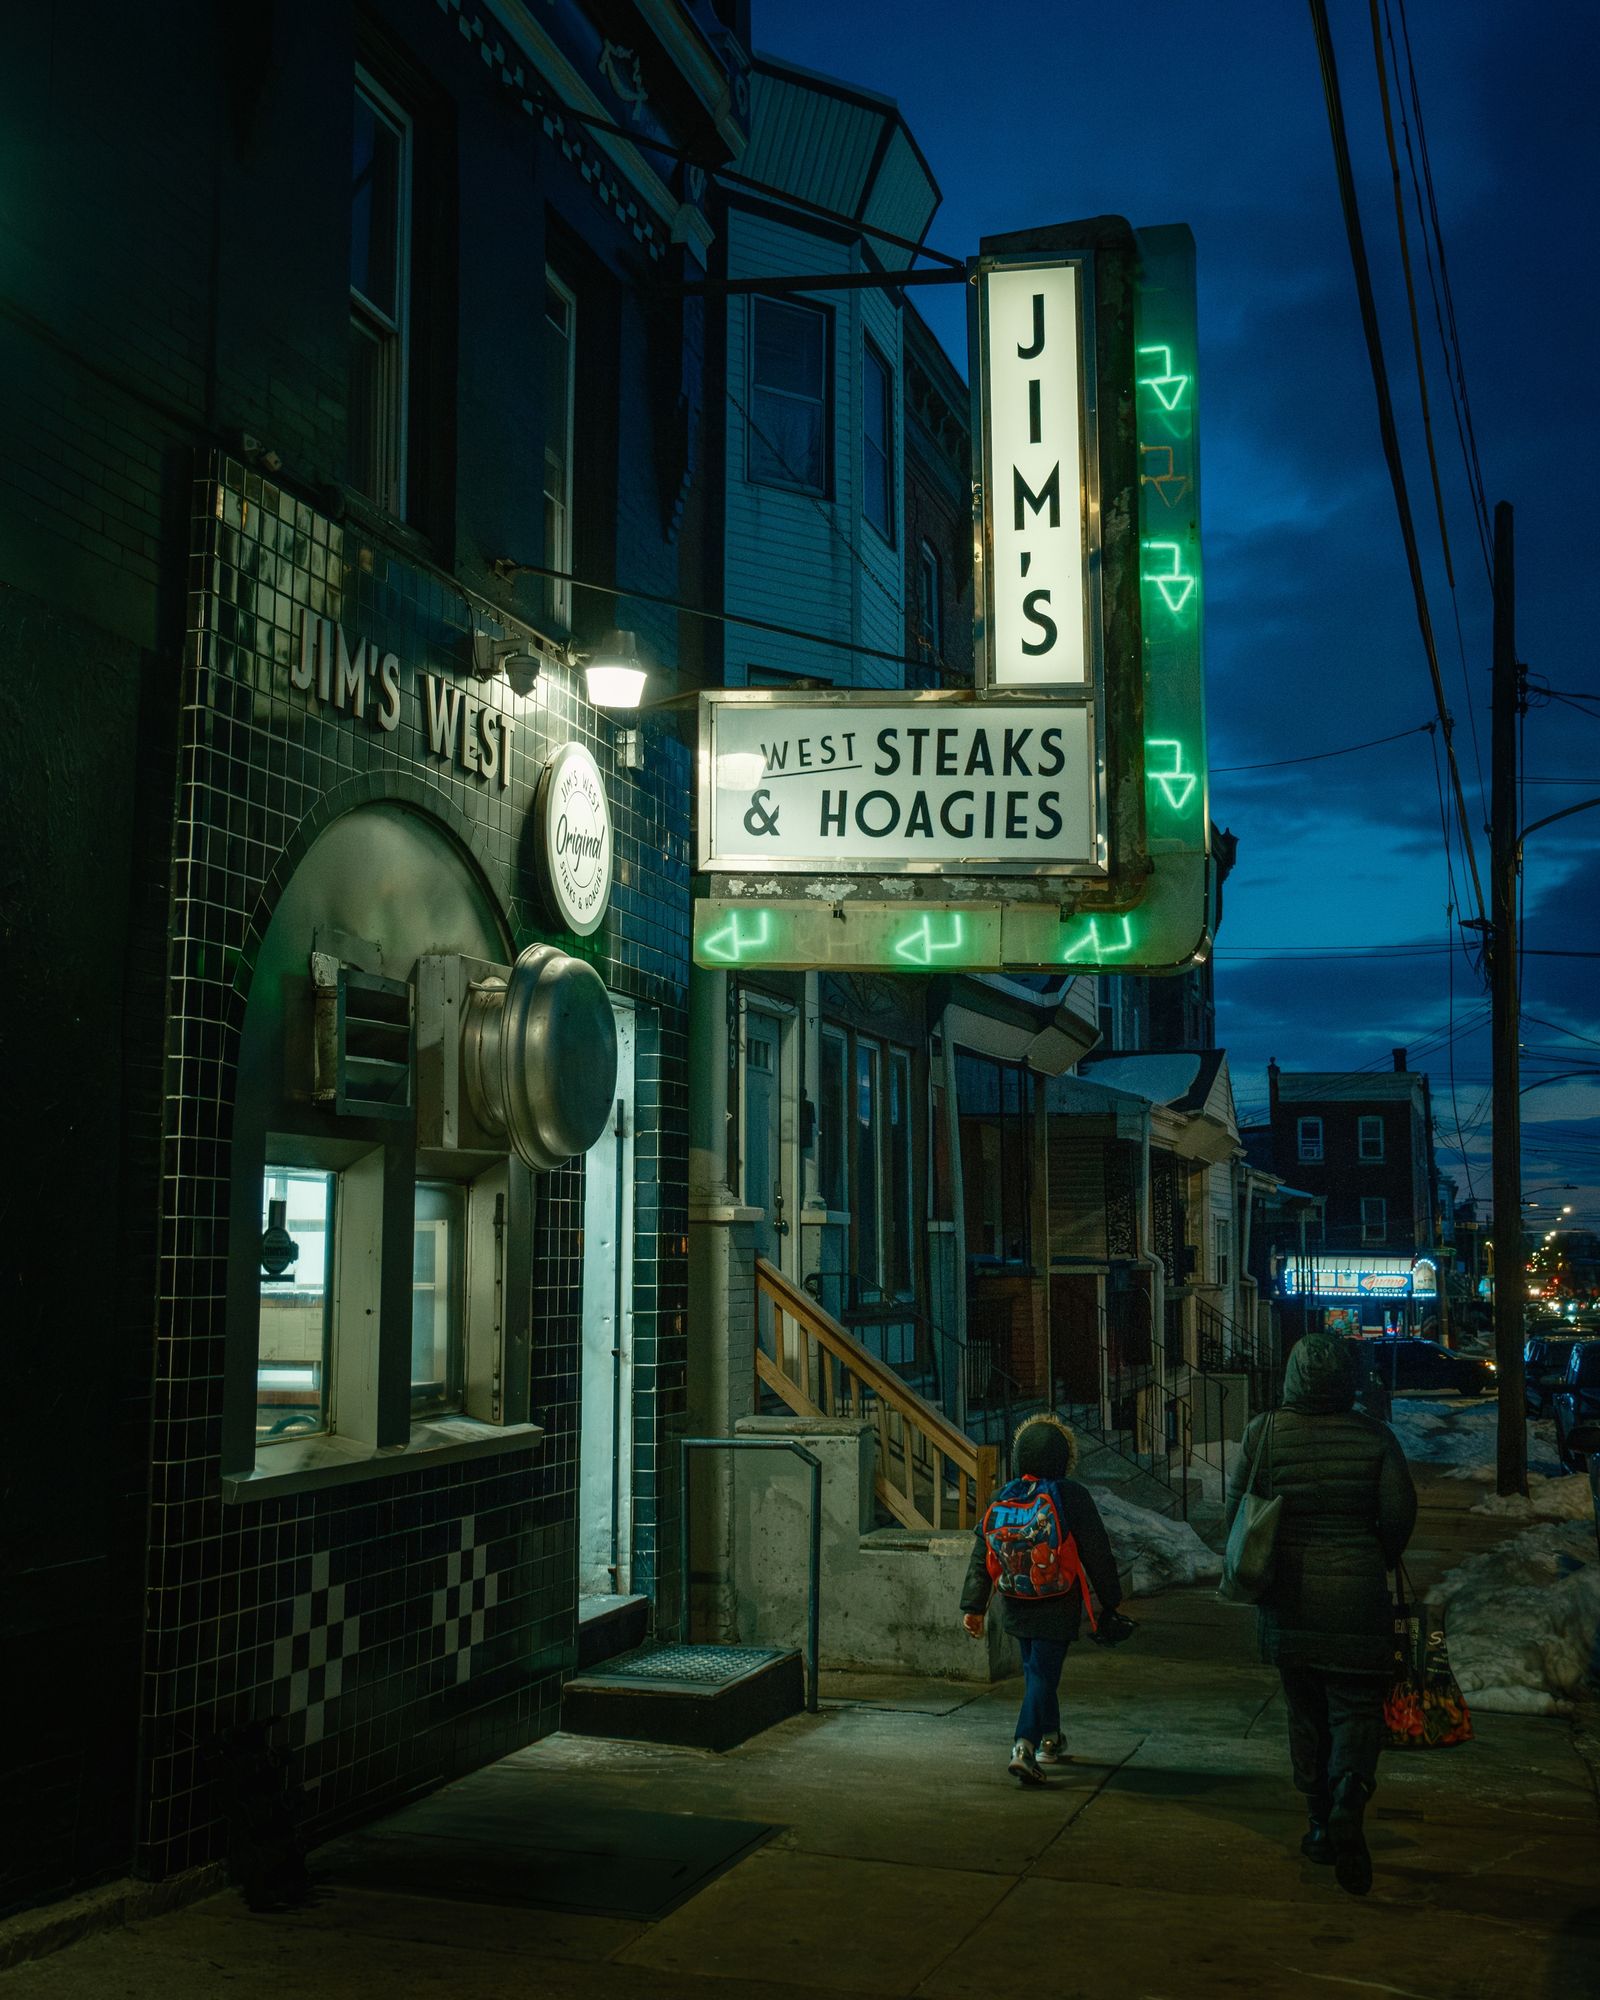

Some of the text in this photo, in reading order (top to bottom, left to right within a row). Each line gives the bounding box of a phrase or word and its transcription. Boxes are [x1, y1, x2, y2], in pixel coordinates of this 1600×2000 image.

[1013, 293, 1061, 656] JIM'S
[291, 608, 516, 788] JIM'S WEST
[760, 727, 1066, 778] WEST STEAKS
[561, 769, 601, 814] JIM'S WEST
[744, 788, 1063, 840] & HOAGIES
[556, 813, 606, 873] Original
[559, 860, 604, 910] STEAKS & HOAGIES
